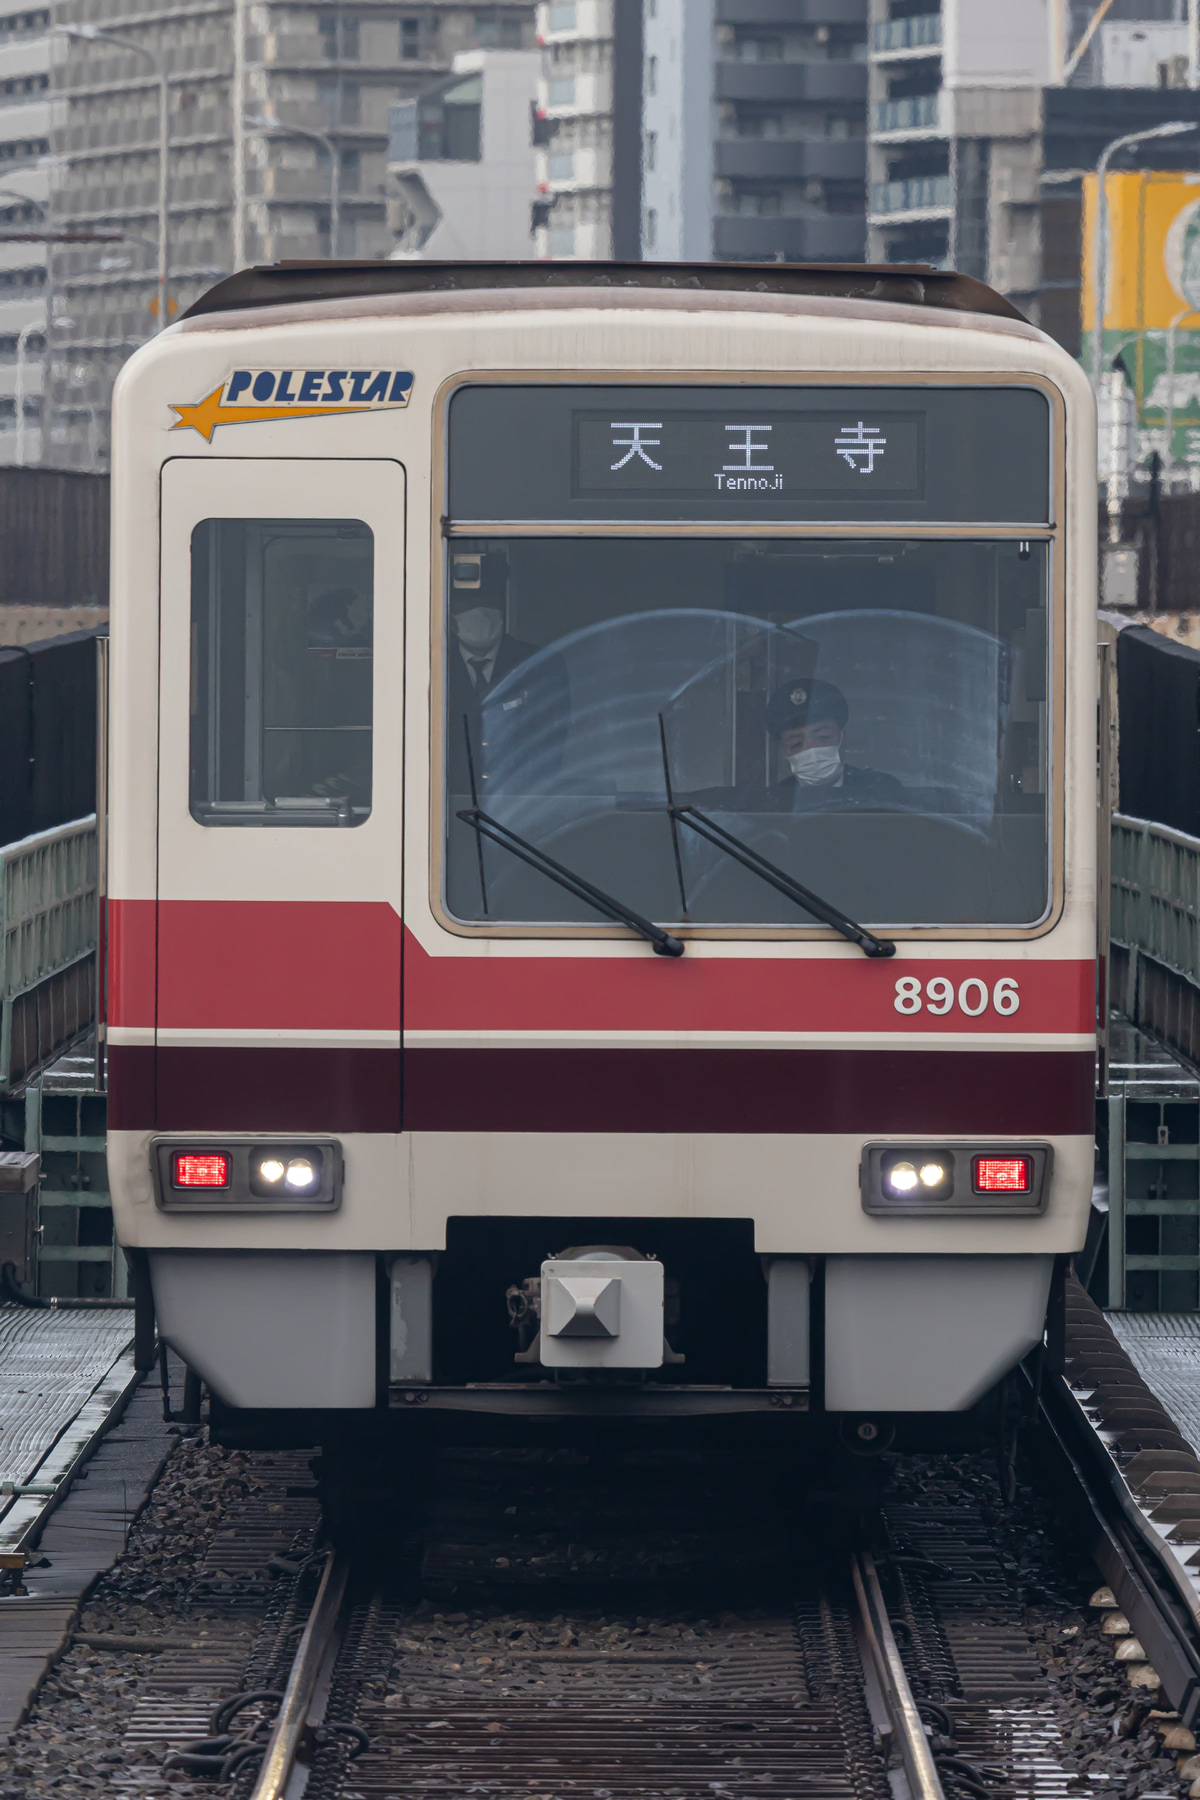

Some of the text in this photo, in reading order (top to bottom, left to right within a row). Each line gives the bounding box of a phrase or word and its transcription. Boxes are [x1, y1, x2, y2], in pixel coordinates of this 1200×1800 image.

[226, 371, 413, 402] POLESTAR
[610, 421, 887, 473] 天王寺
[713, 473, 783, 490] Tennoji
[893, 976, 1020, 1017] 8906
